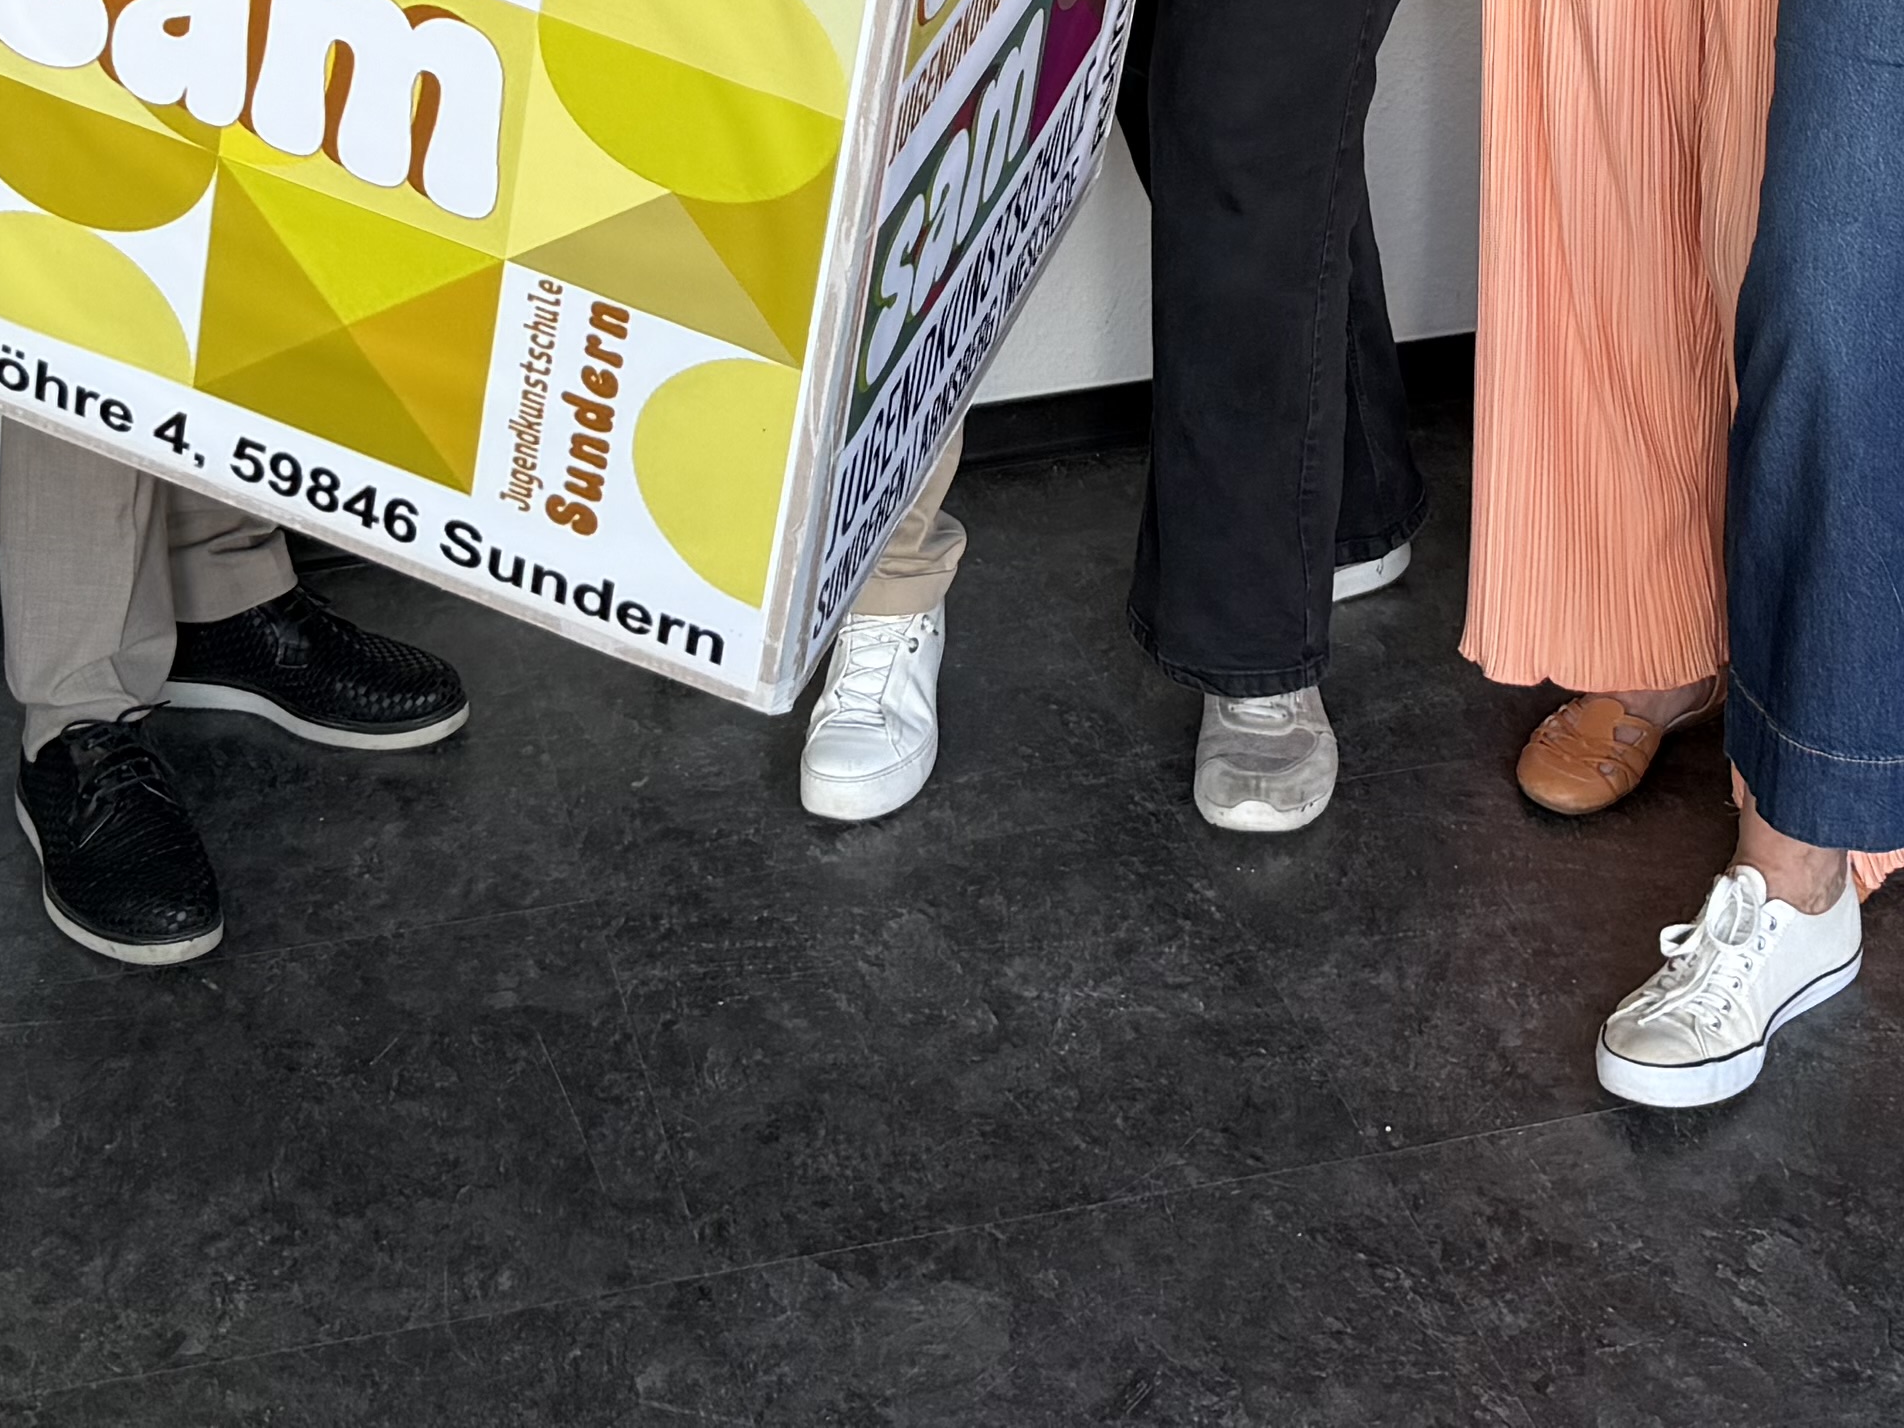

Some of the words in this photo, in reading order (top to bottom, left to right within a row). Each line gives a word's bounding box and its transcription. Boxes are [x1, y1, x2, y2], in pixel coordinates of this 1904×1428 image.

[824, 55, 1098, 563] JUGENDKUNSTSCHULE
[858, 6, 1045, 393] sam
[499, 278, 564, 513] Jugendkunstschule
[544, 300, 631, 537] Sundern
[152, 410, 206, 469] 4,
[229, 436, 420, 545] 59846
[439, 518, 726, 667] Sundern
